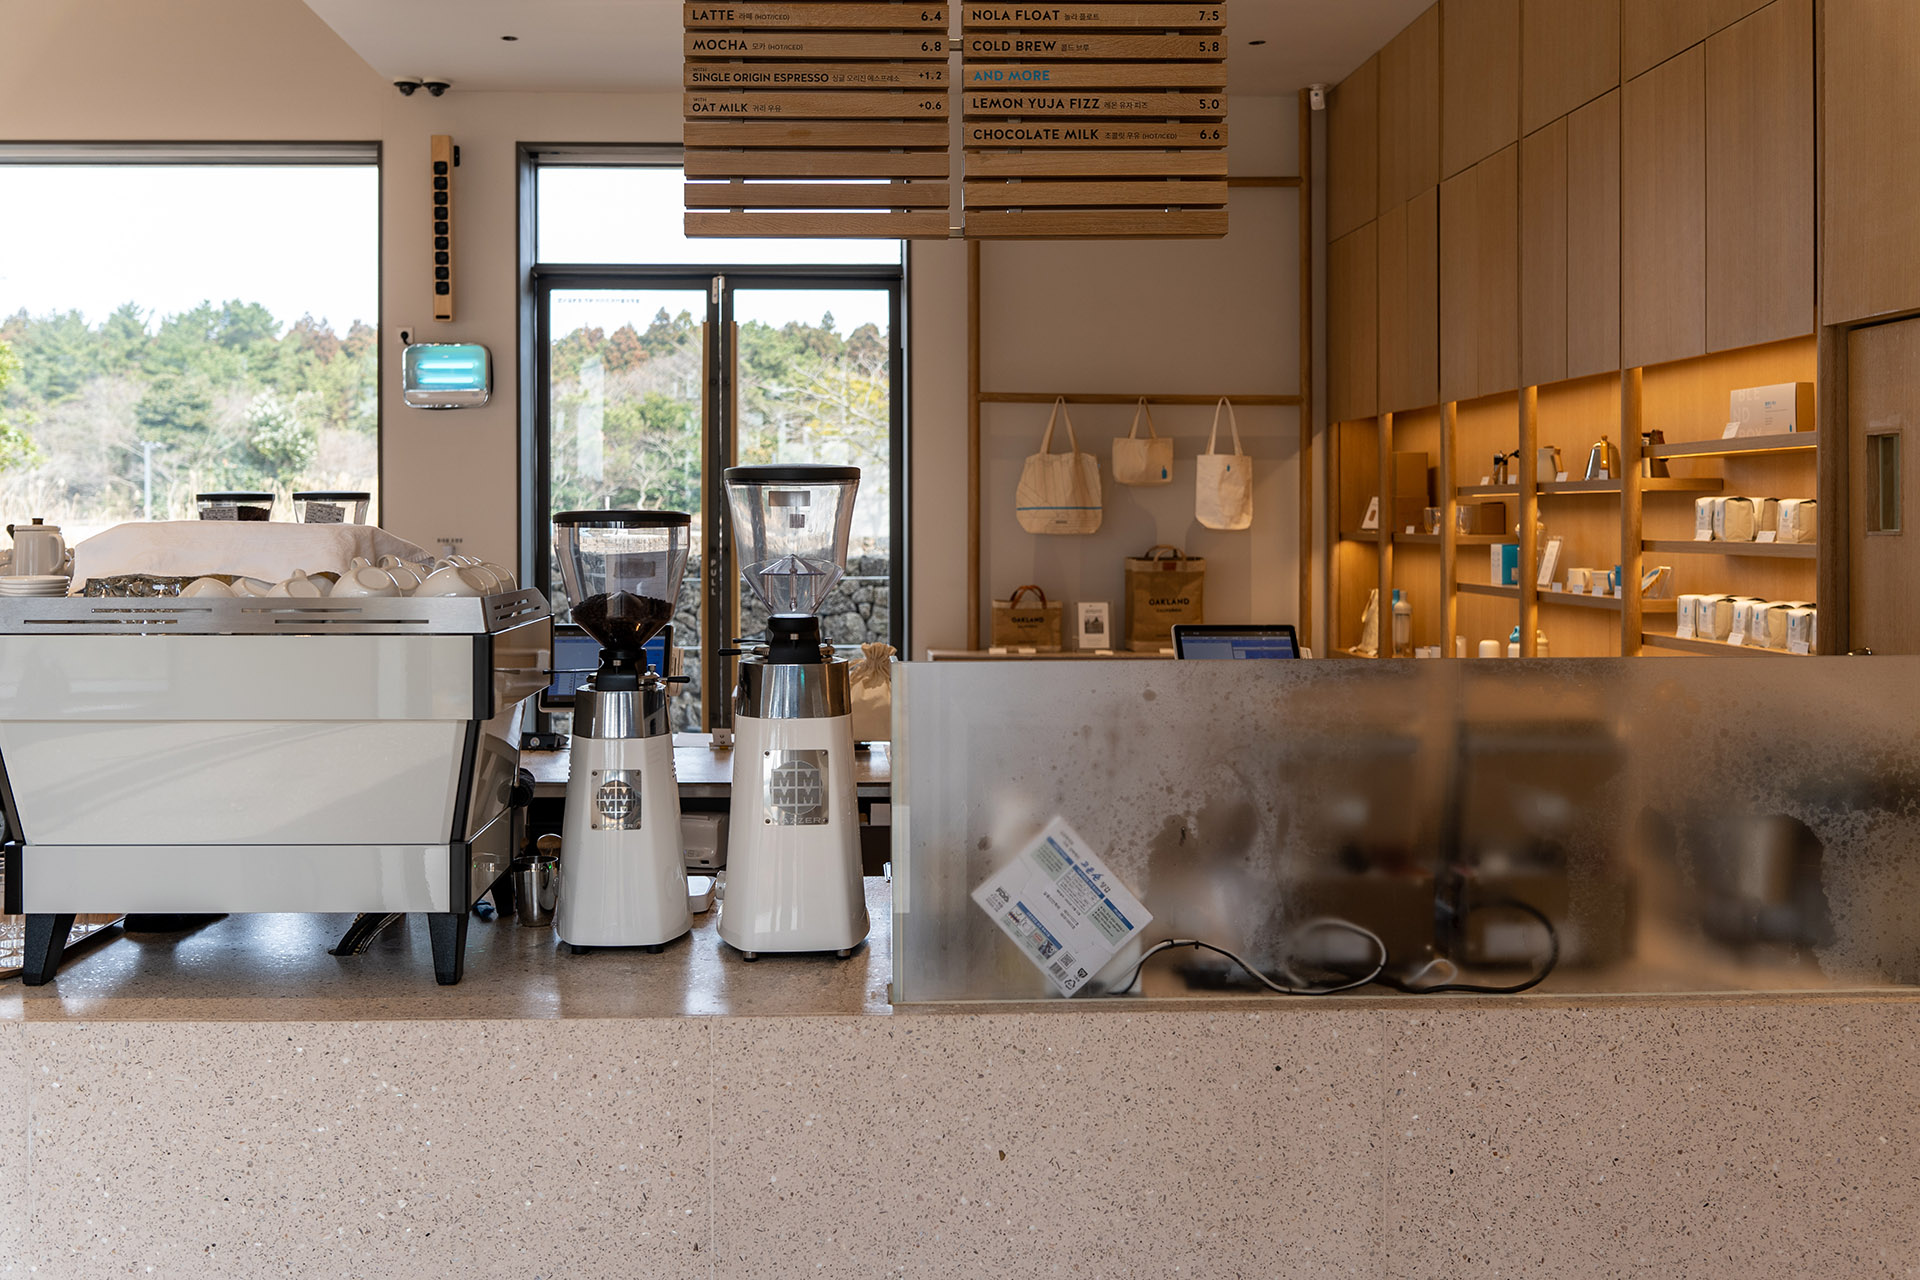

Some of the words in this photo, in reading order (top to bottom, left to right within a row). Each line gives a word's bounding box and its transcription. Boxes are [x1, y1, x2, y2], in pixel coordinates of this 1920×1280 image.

[693, 10, 734, 21] LATTE
[921, 11, 941, 21] 6.4
[972, 10, 1011, 21] NOLA
[1016, 10, 1060, 21] FLOAT
[1199, 11, 1219, 21] 7.5
[692, 40, 748, 50] MOCHA
[921, 41, 941, 52] 6.8
[972, 41, 1011, 51] COLD
[1016, 41, 1056, 51] BREW
[1199, 42, 1219, 52] 5.8
[692, 73, 731, 82] SINGLE
[733, 73, 770, 82] ORIGIN
[774, 73, 829, 82] ESPRESSO
[832, 74, 844, 82] 싱글
[846, 74, 866, 82] 오리진
[919, 71, 941, 80] +1.2
[974, 70, 1004, 81] AND
[1008, 70, 1050, 81] MORE
[692, 103, 716, 112] OAT
[719, 103, 748, 112] MILK
[919, 101, 941, 110] +0.6
[973, 98, 1023, 109] LEMON
[1028, 98, 1064, 109] YUJA
[1070, 98, 1100, 109] FIZZ
[1119, 101, 1133, 109] 유자
[1199, 99, 1219, 109] 5.0
[974, 129, 1060, 140] CHOCOLATE
[1064, 129, 1099, 140] MILK
[1126, 132, 1140, 140] 우유
[1200, 130, 1220, 140] 6.6
[1149, 598, 1190, 606] OAKLAND
